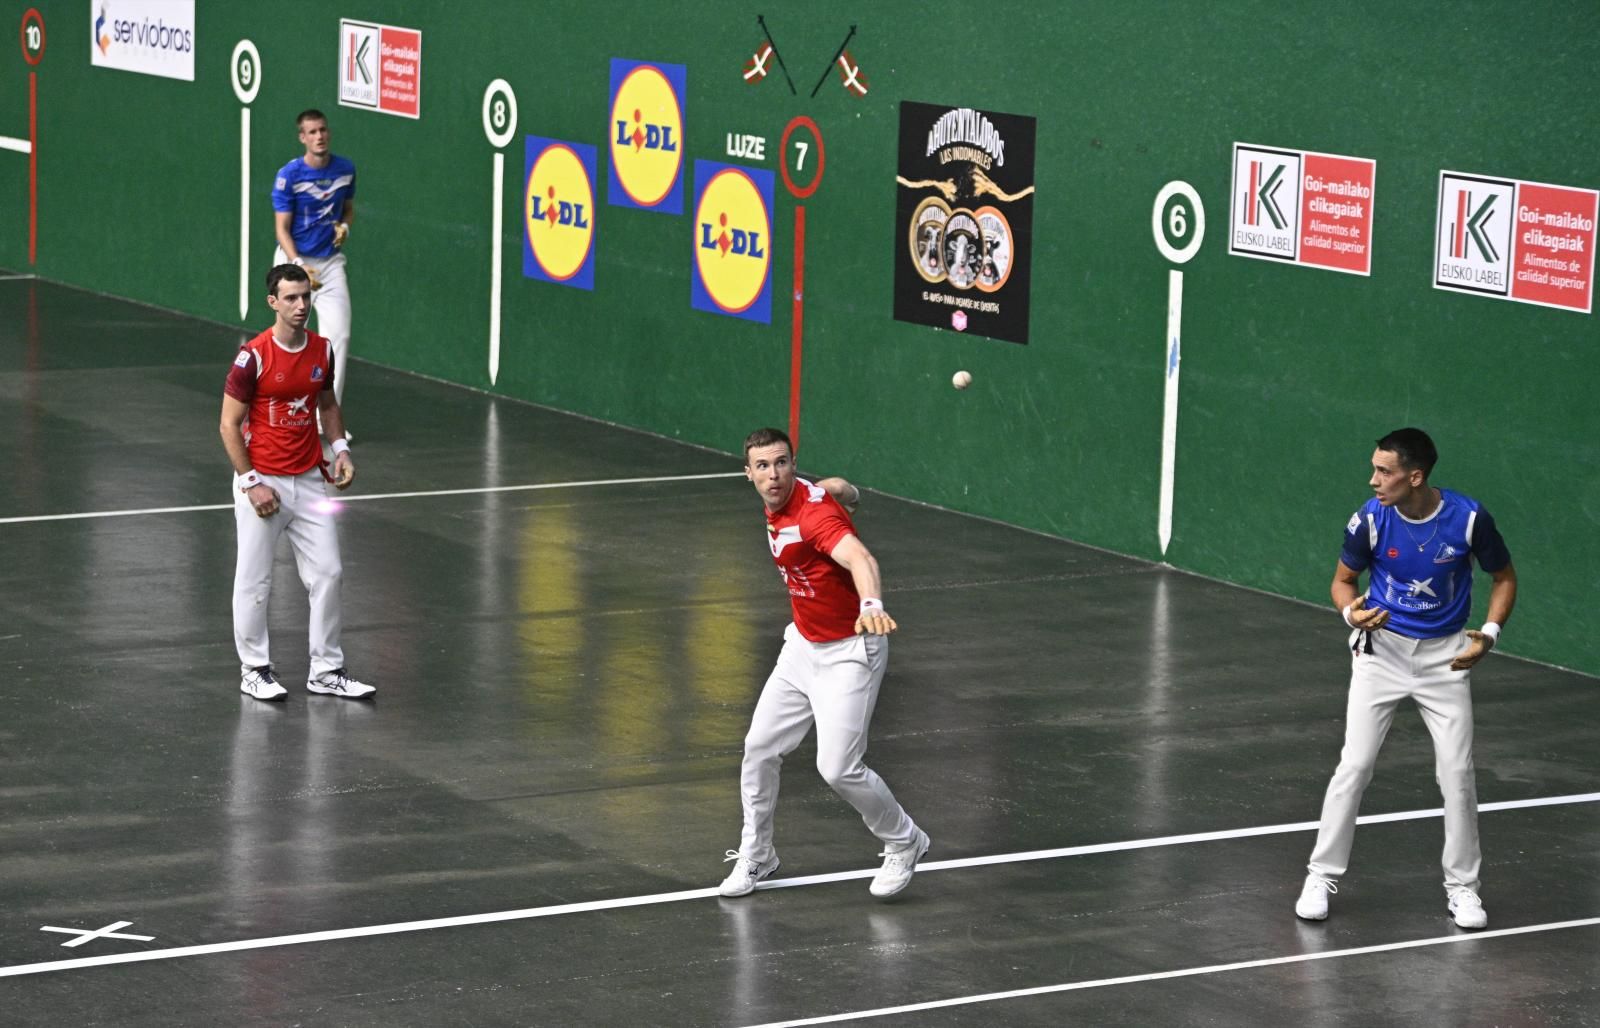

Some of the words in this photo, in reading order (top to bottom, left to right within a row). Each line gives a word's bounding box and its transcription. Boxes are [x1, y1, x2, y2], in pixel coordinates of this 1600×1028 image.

[26, 25, 41, 50] 10
[114, 16, 191, 53] serviobras
[241, 59, 251, 82] 9
[493, 100, 506, 128] 8
[727, 133, 766, 160] LUZE
[926, 108, 1004, 167] AHUYENTALOBOS
[795, 142, 808, 171] 7
[1305, 175, 1370, 199] Goi-mailako
[1309, 197, 1363, 219] elikagaiak
[1519, 206, 1593, 231] Goi-mailako
[1169, 205, 1187, 238] 6
[1309, 219, 1349, 237] Alimentos
[1349, 226, 1360, 238] de
[1236, 230, 1264, 247] EUSKO
[1266, 235, 1293, 252] LABEL
[1304, 235, 1332, 249] calidad
[1332, 239, 1365, 254] superior
[1523, 229, 1585, 253] elikagaiak
[1441, 263, 1473, 281] EUSKO
[1475, 269, 1504, 287] LABEL
[1523, 253, 1567, 271] Alimentos
[1569, 261, 1581, 273] de
[1517, 269, 1549, 285] calidad
[1549, 274, 1586, 290] superior
